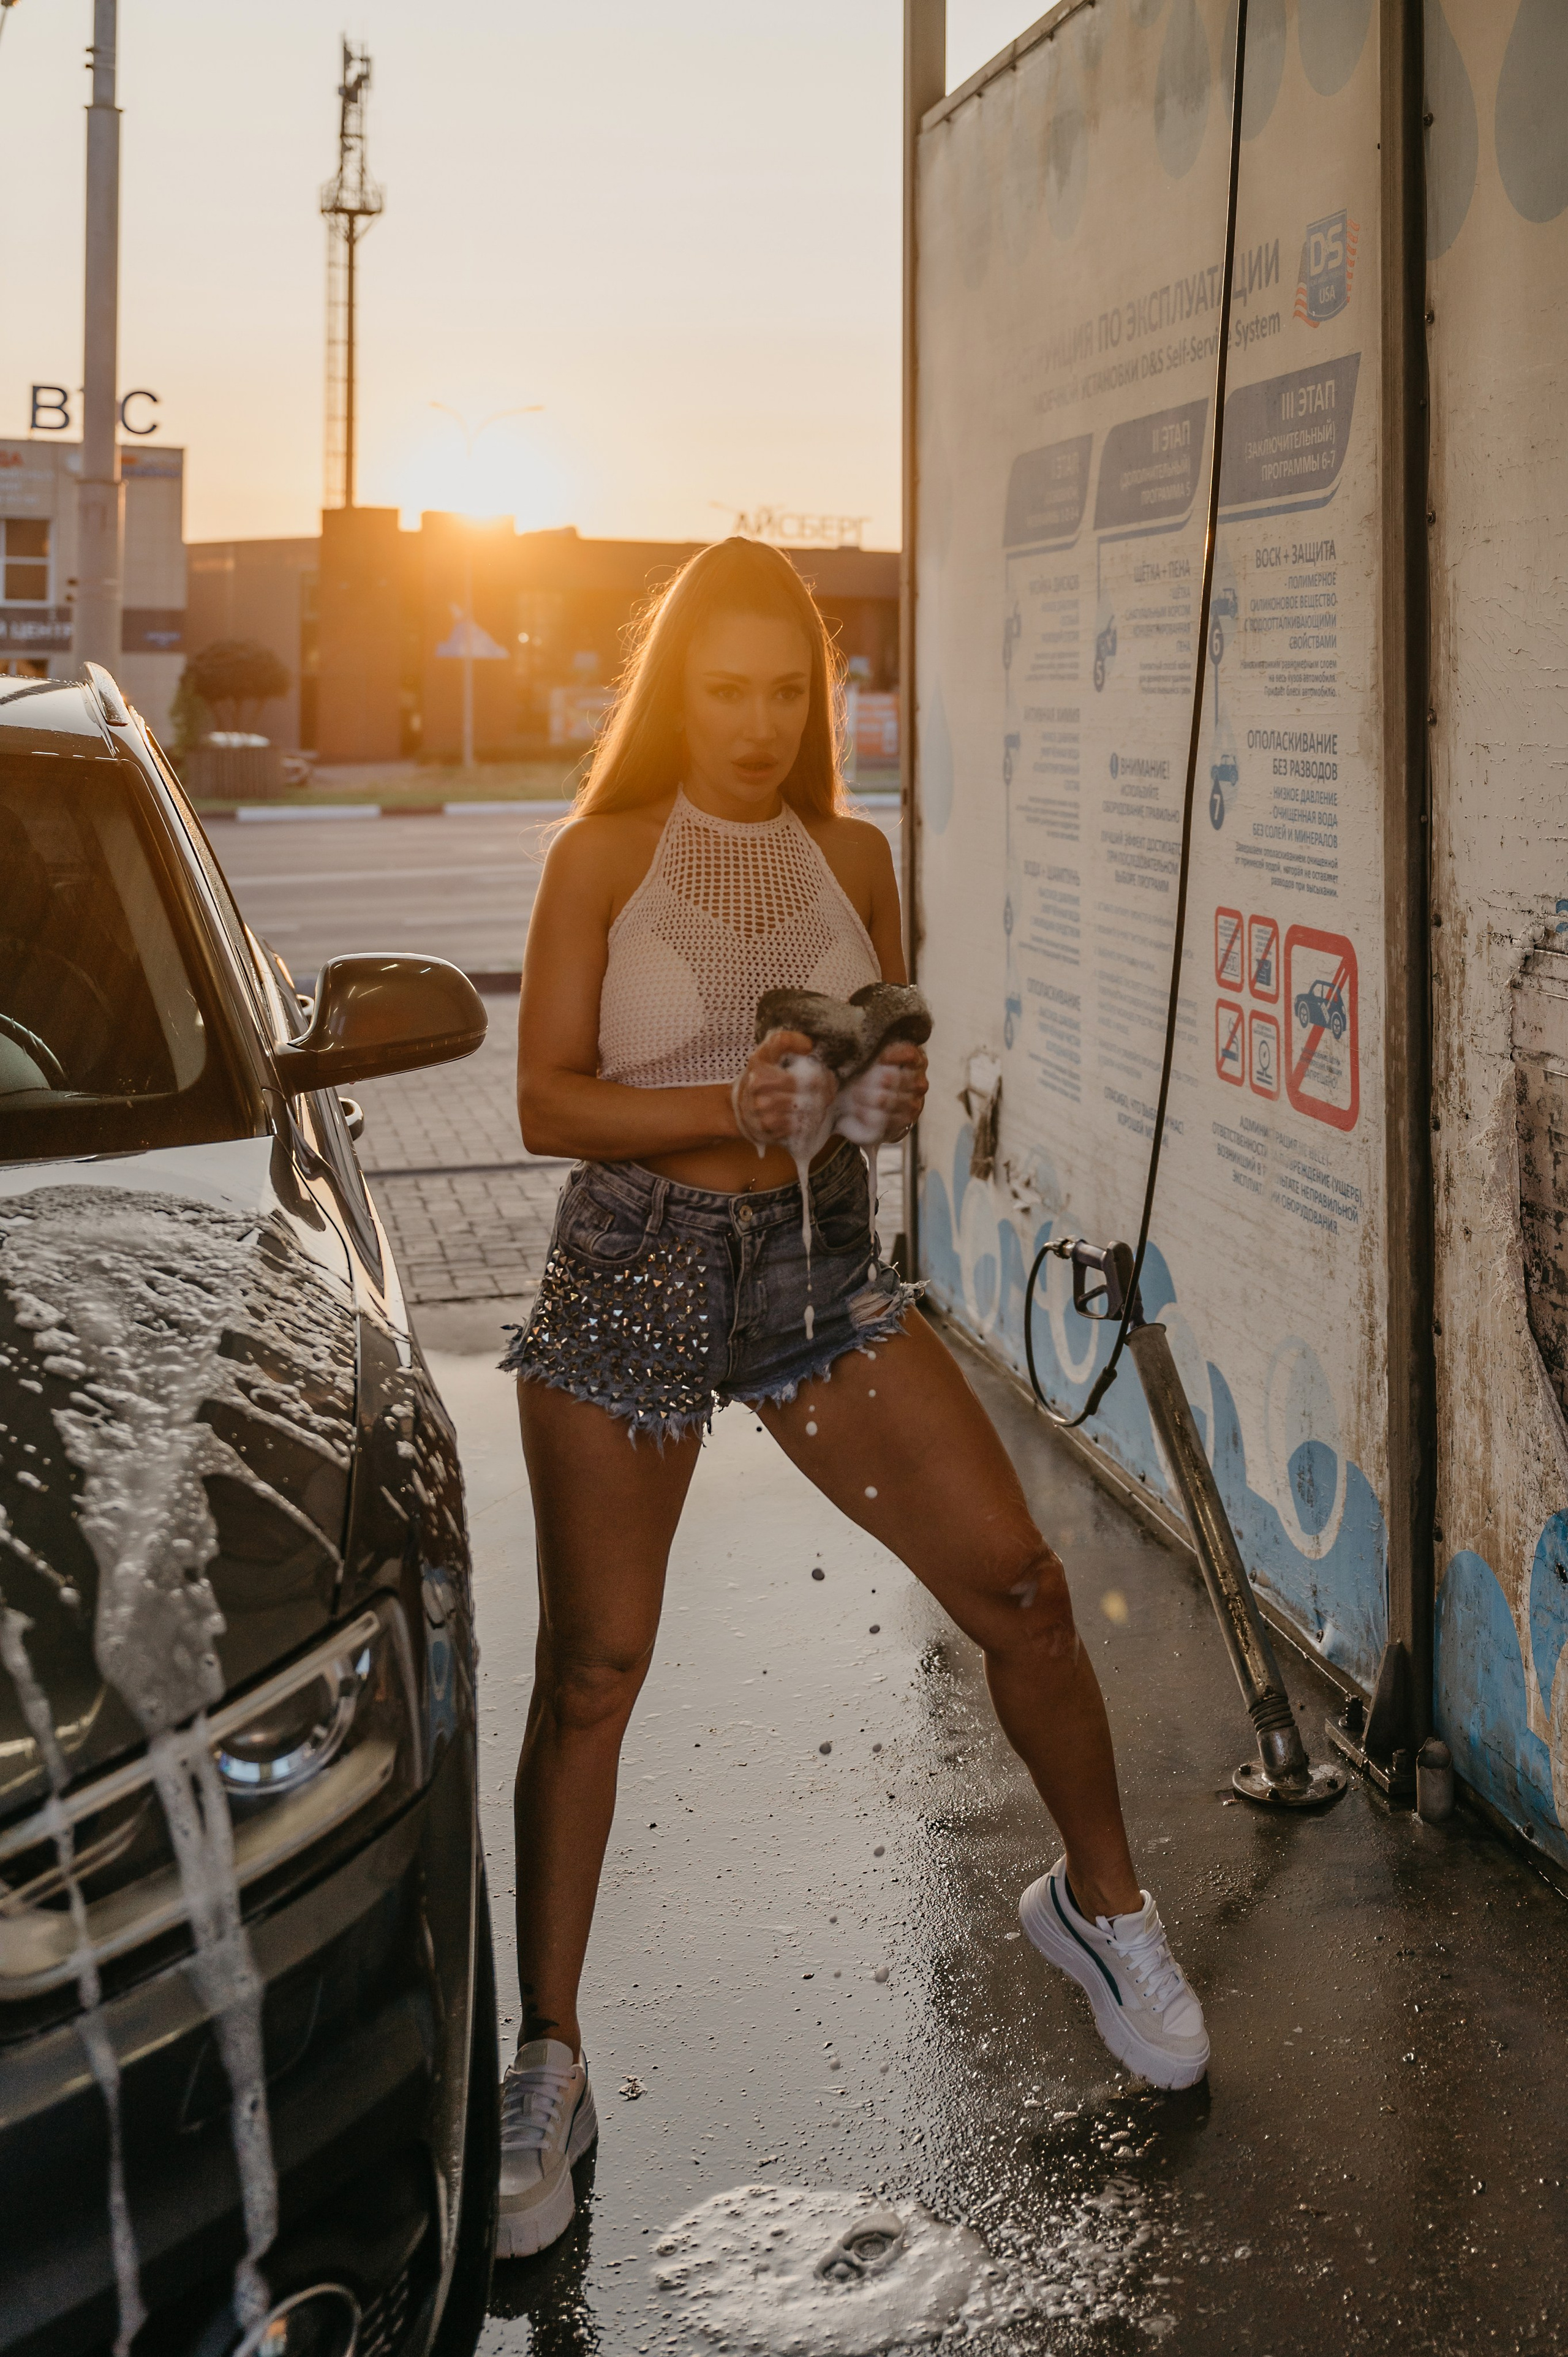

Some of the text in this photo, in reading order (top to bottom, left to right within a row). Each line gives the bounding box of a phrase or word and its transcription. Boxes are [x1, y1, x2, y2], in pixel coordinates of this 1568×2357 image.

[1319, 285, 1336, 304] USA
[1098, 307, 1121, 353] ПО
[1142, 347, 1164, 380] D&S
[1235, 312, 1281, 351] System
[1282, 379, 1335, 421] III ЭТАП
[1162, 420, 1190, 451] ЭТАП
[1245, 418, 1336, 464] (ЗАКЛЮЧИТЕЛЬНЫЙ)
[1262, 450, 1336, 481] ПРОГРАММЫ 6-7
[1256, 540, 1336, 568] ВОСК + ЗАЩИТА
[1288, 571, 1336, 589] ПОЛИМЕРНОЕ
[1213, 630, 1219, 655] 6
[1289, 633, 1336, 649] СВОЙСТВАМИ
[1320, 660, 1336, 669] слоем
[1248, 730, 1338, 755] ОПОЛАСКИВАНИЕ
[1273, 758, 1338, 783] БЕЗ РАЗВОДОВ
[1213, 794, 1220, 820] 7
[1273, 786, 1338, 806] НИЗКОЕ ДАВЛЕНИЕ
[1273, 805, 1338, 829] ОЧИЩЕННАЯ ВОДА
[1253, 823, 1338, 848] БЕЗ СОЛЕЙ И МИНЕРАЛОВ
[1240, 1115, 1298, 1149] АДМИНИРАЦИЯ
[1232, 1169, 1340, 1235] ЭКСПЛУАТИИ ОБОРУДОВАНИЯ.
[1257, 1162, 1261, 1175] В
[1301, 1183, 1359, 1224] НЕПРАВИЛЬНОЙ
